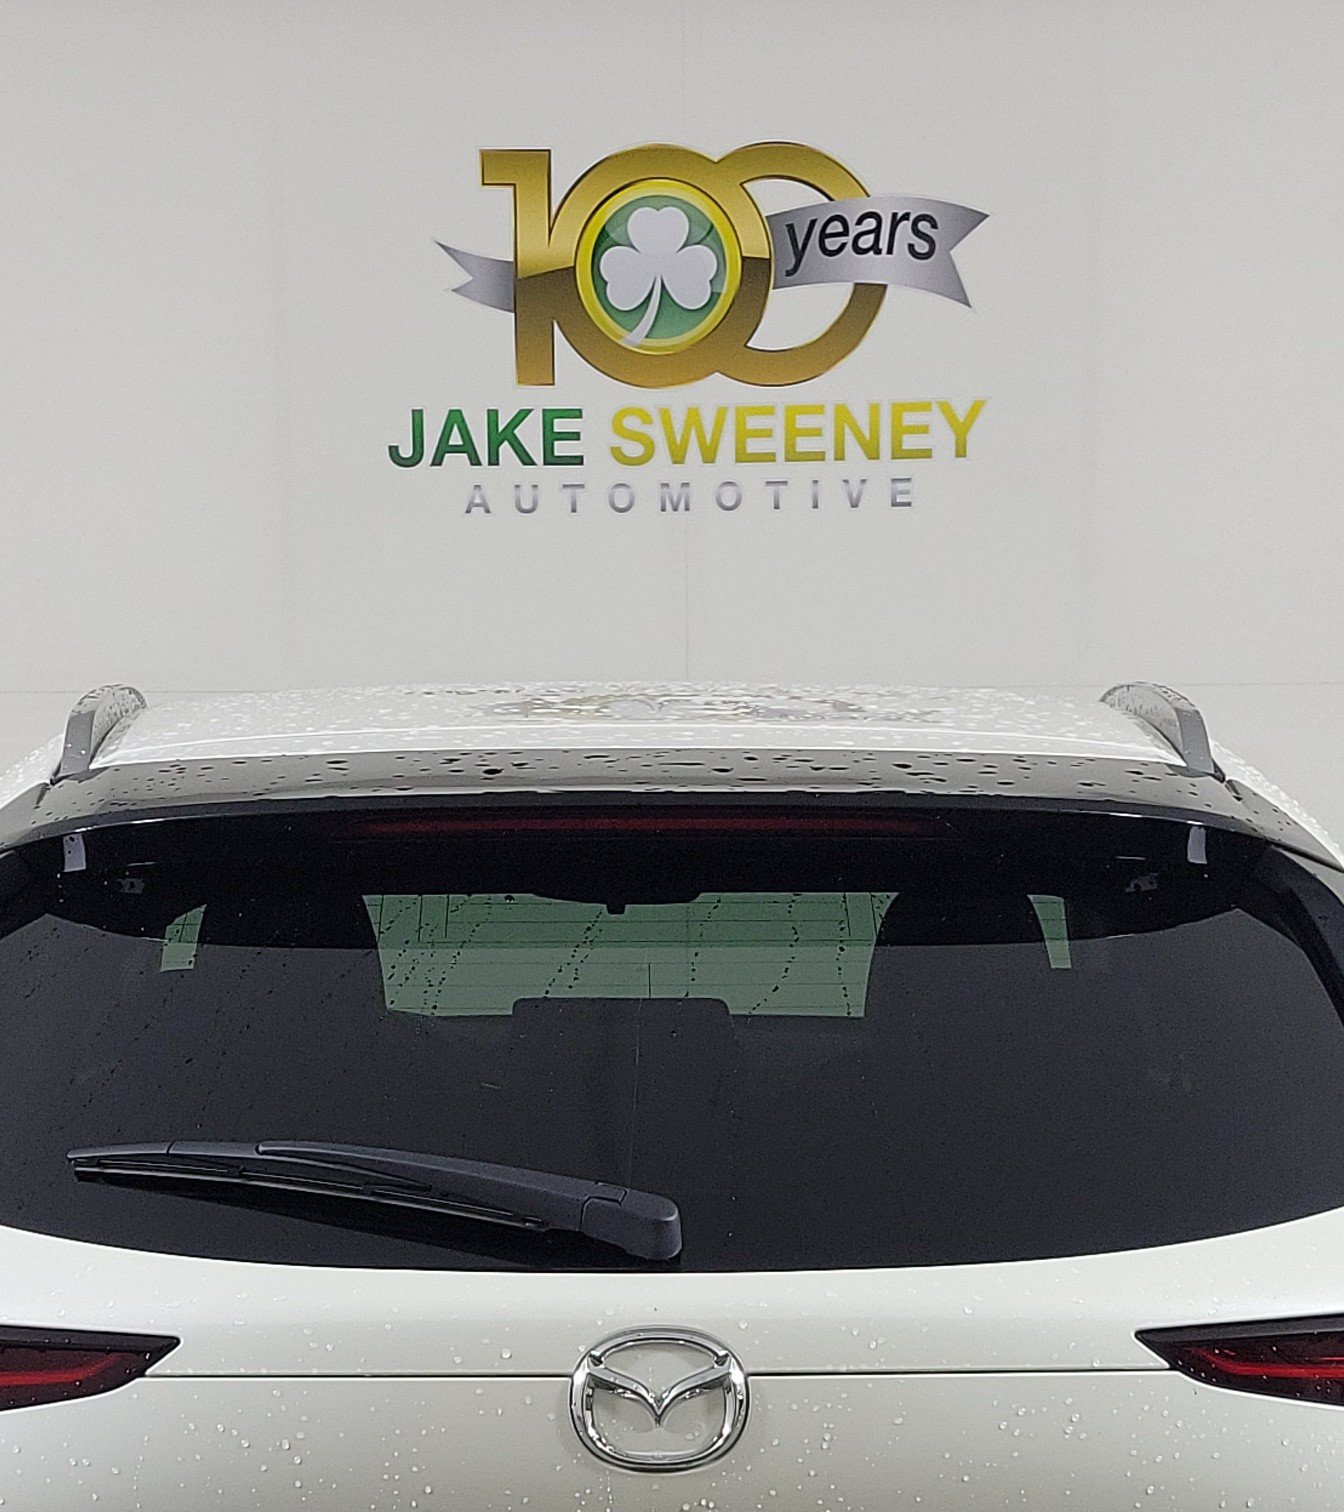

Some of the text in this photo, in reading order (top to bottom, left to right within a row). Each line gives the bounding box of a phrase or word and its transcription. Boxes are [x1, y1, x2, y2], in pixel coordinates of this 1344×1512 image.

[480, 141, 887, 389] 100
[784, 203, 939, 277] years
[388, 399, 987, 467] JAKE SWEENEY
[464, 476, 914, 515] AUTOMOTIVE
